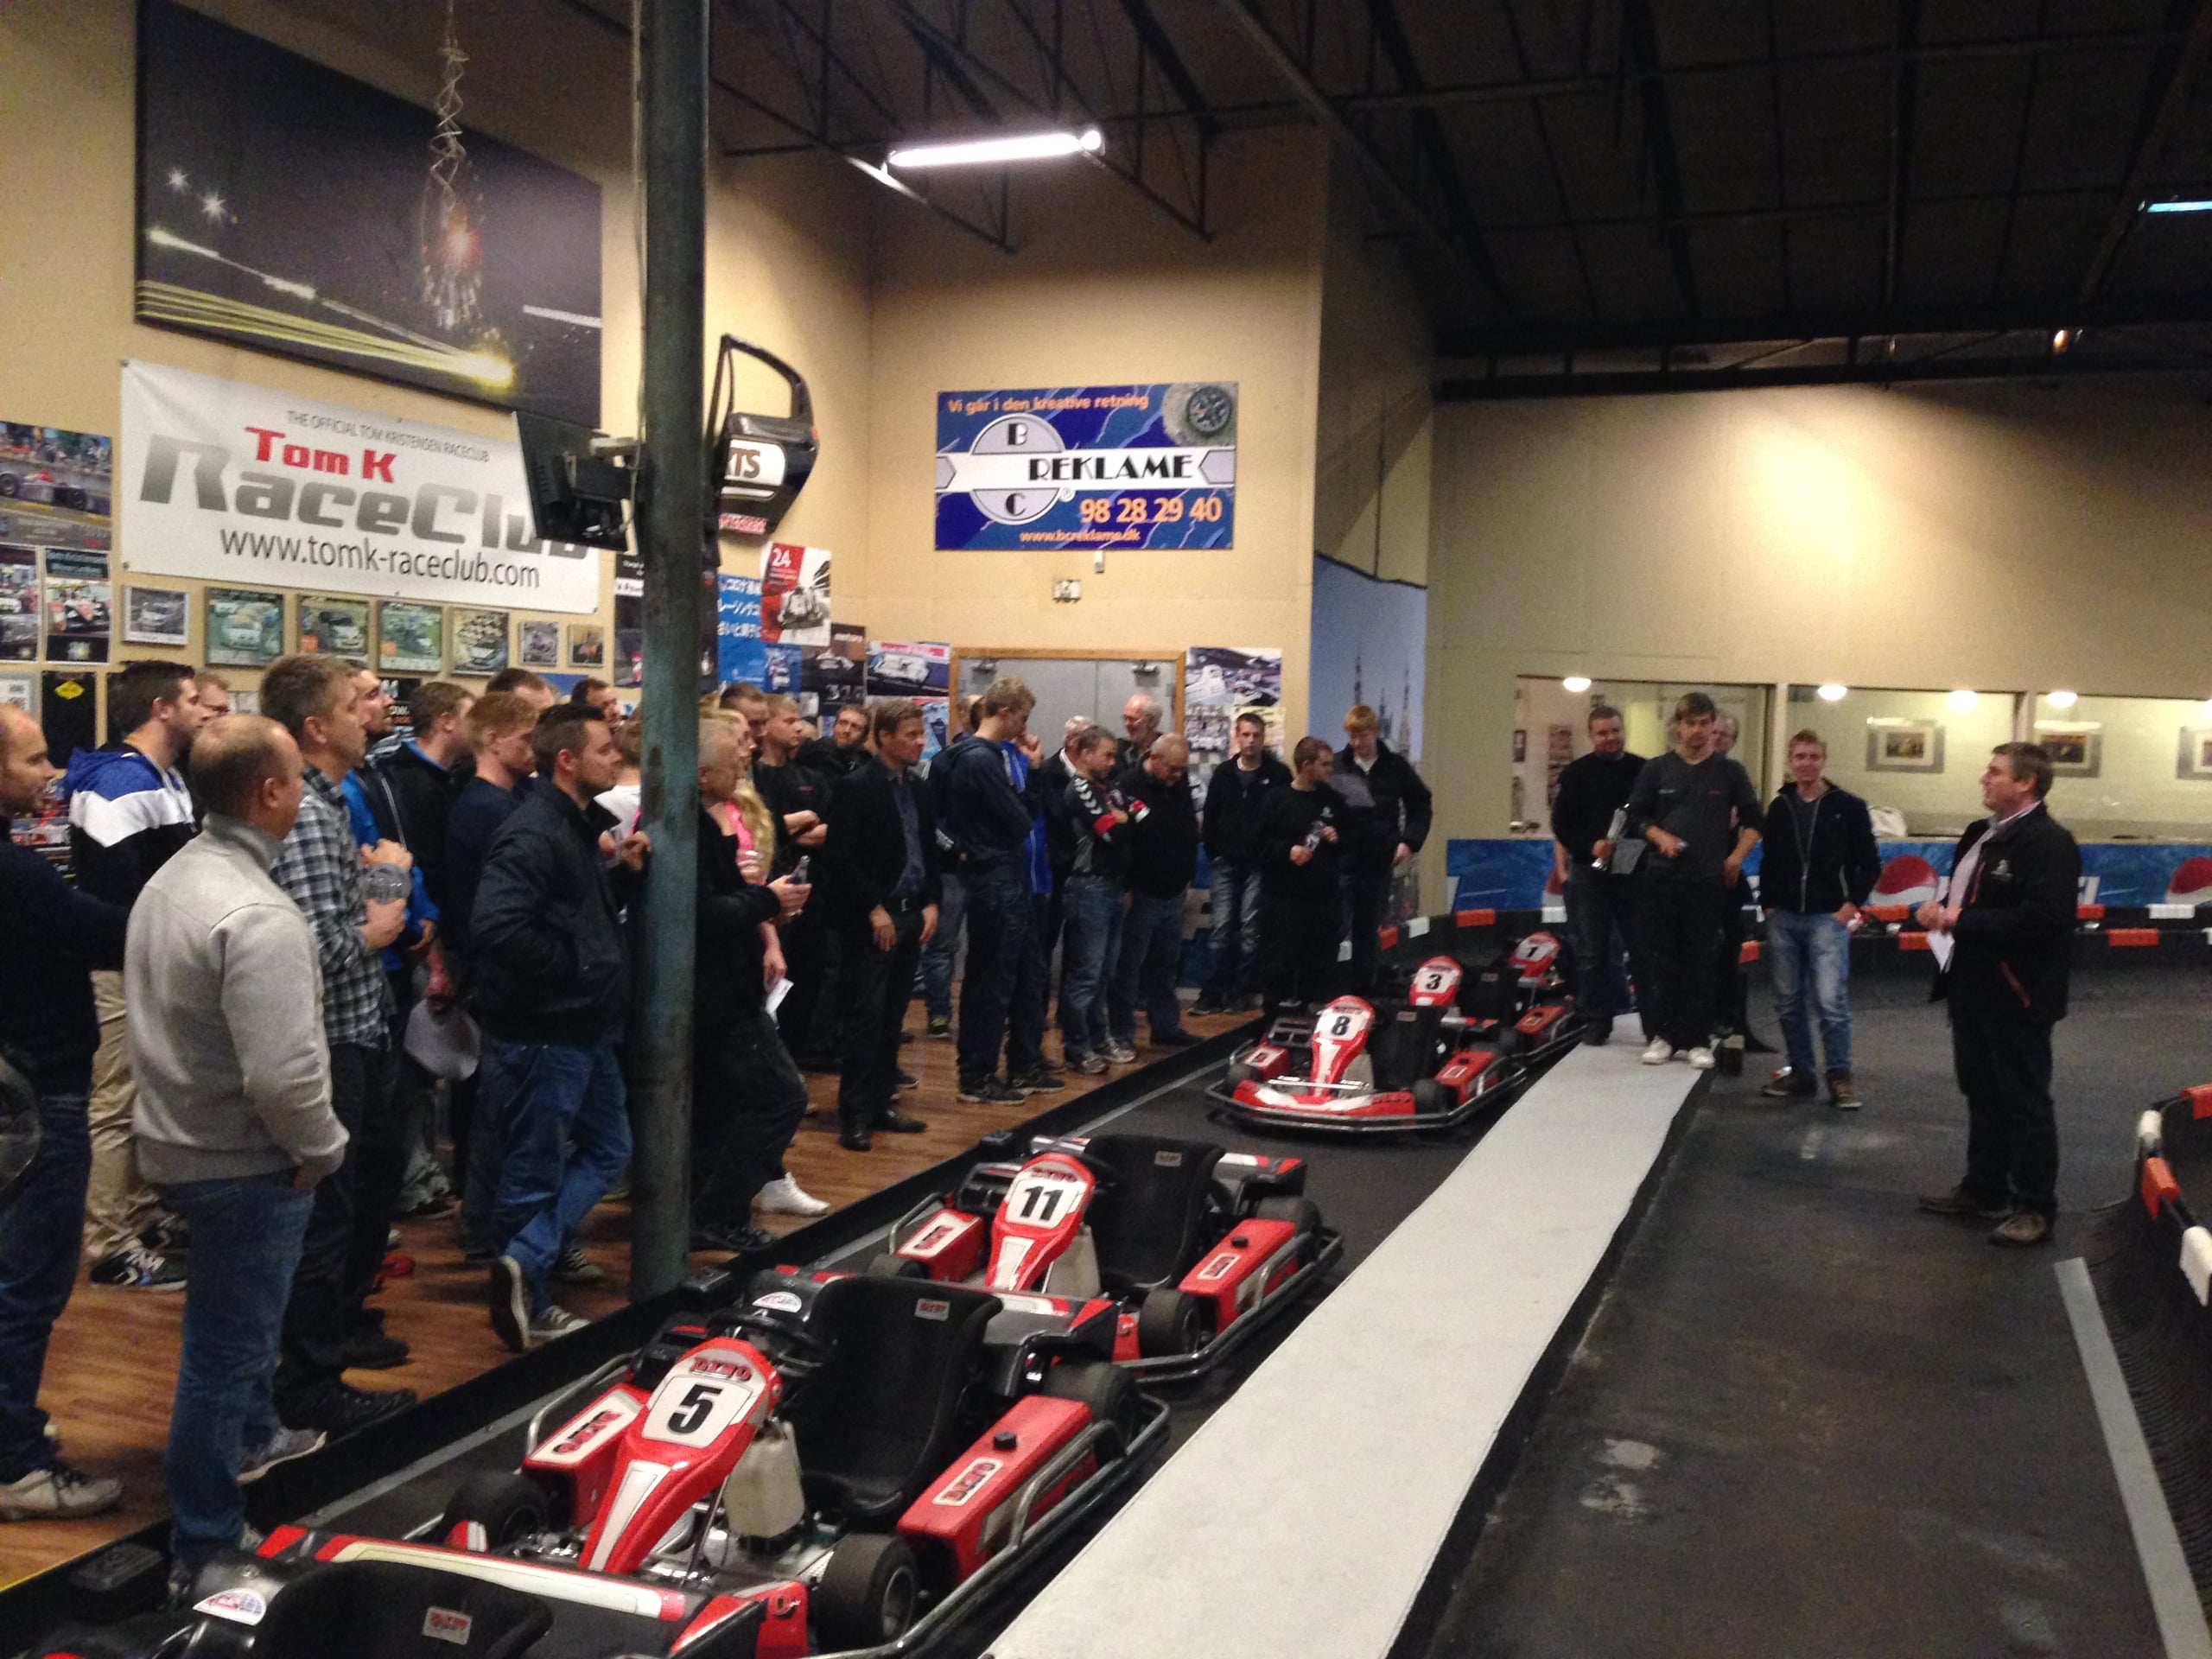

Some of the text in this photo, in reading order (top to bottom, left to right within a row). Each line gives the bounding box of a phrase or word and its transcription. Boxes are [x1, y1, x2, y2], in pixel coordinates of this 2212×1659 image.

[947, 399, 963, 413] Vi
[994, 397, 1000, 411] i
[1002, 396, 1030, 411] den
[1033, 395, 1092, 411] kreative
[286, 410, 309, 428] THE
[311, 415, 358, 437] OFFICIAL
[359, 423, 384, 442] TOM
[1007, 422, 1029, 447] B
[245, 427, 397, 484] Tom K
[1027, 454, 1194, 482] REKLAME
[140, 434, 589, 561] RaceClu
[1005, 493, 1027, 517] C
[1080, 497, 1224, 524] 98 28 29 40
[219, 527, 541, 589] www.tomk-raceclub.com
[772, 547, 792, 568] 24
[1426, 973, 1443, 990] 3
[1331, 1014, 1351, 1037] 8
[1020, 1185, 1065, 1223] 11
[667, 1383, 725, 1435] 5
